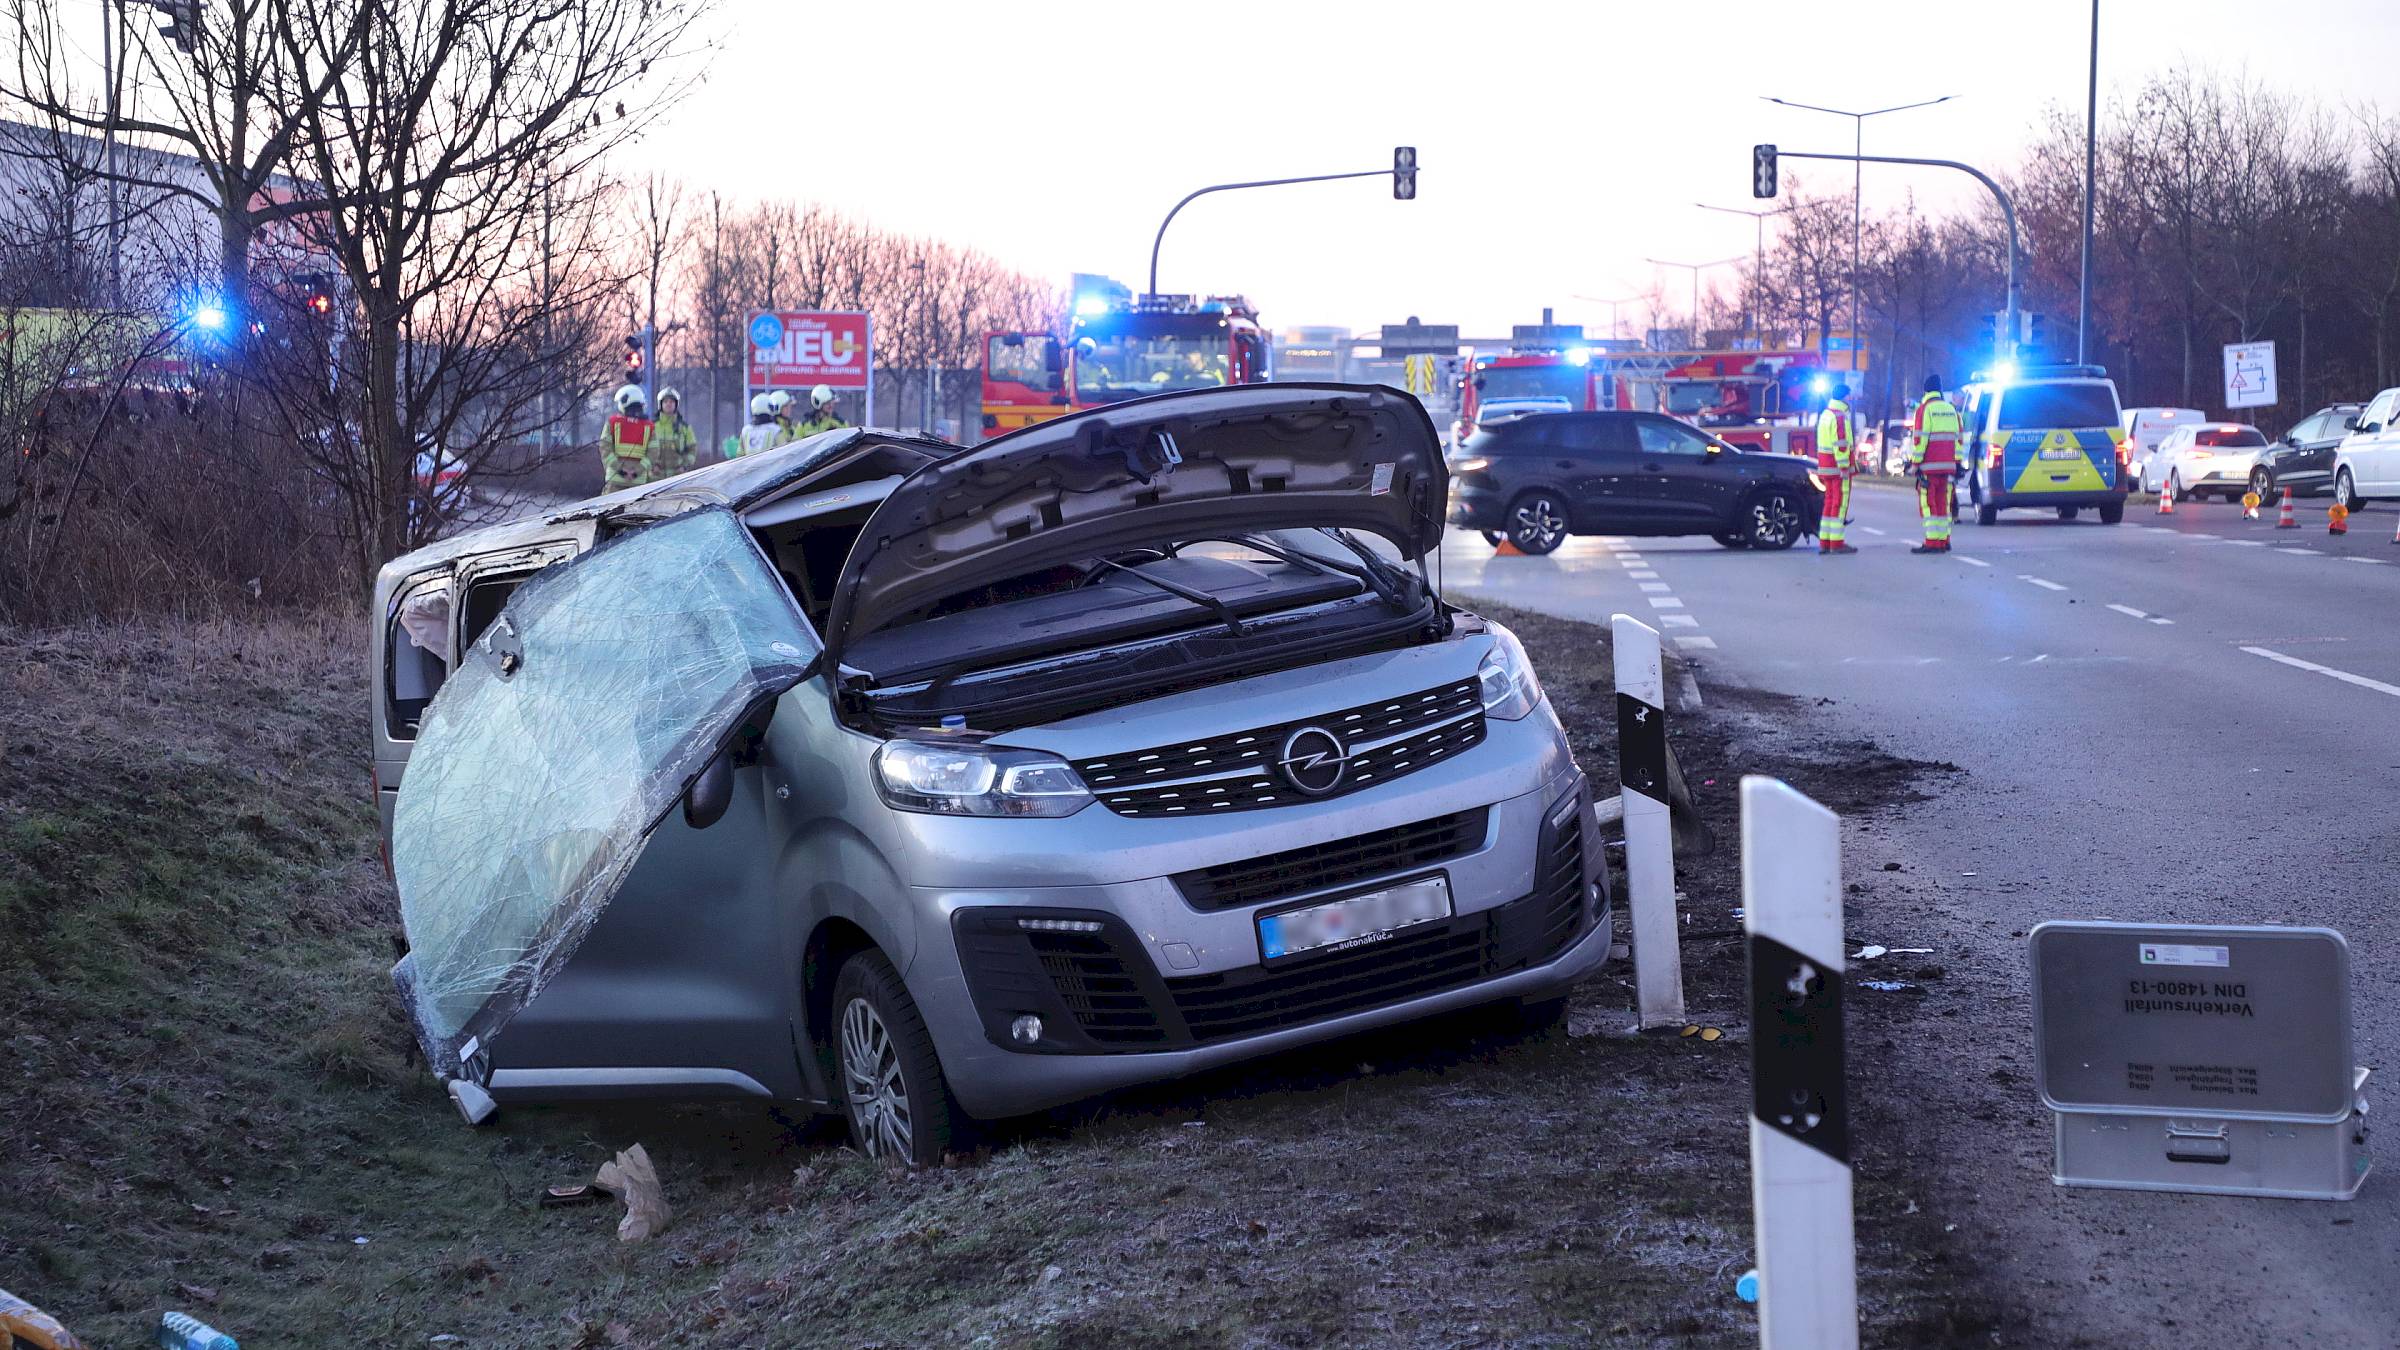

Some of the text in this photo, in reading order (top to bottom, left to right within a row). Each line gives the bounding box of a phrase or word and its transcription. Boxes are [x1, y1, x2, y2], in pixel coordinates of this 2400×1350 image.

[774, 331, 854, 365] NEU
[2011, 435, 2043, 443] POLIZEI
[2129, 981, 2246, 997] DIN 14800-13
[2124, 999, 2254, 1017] Verkehrsunfall
